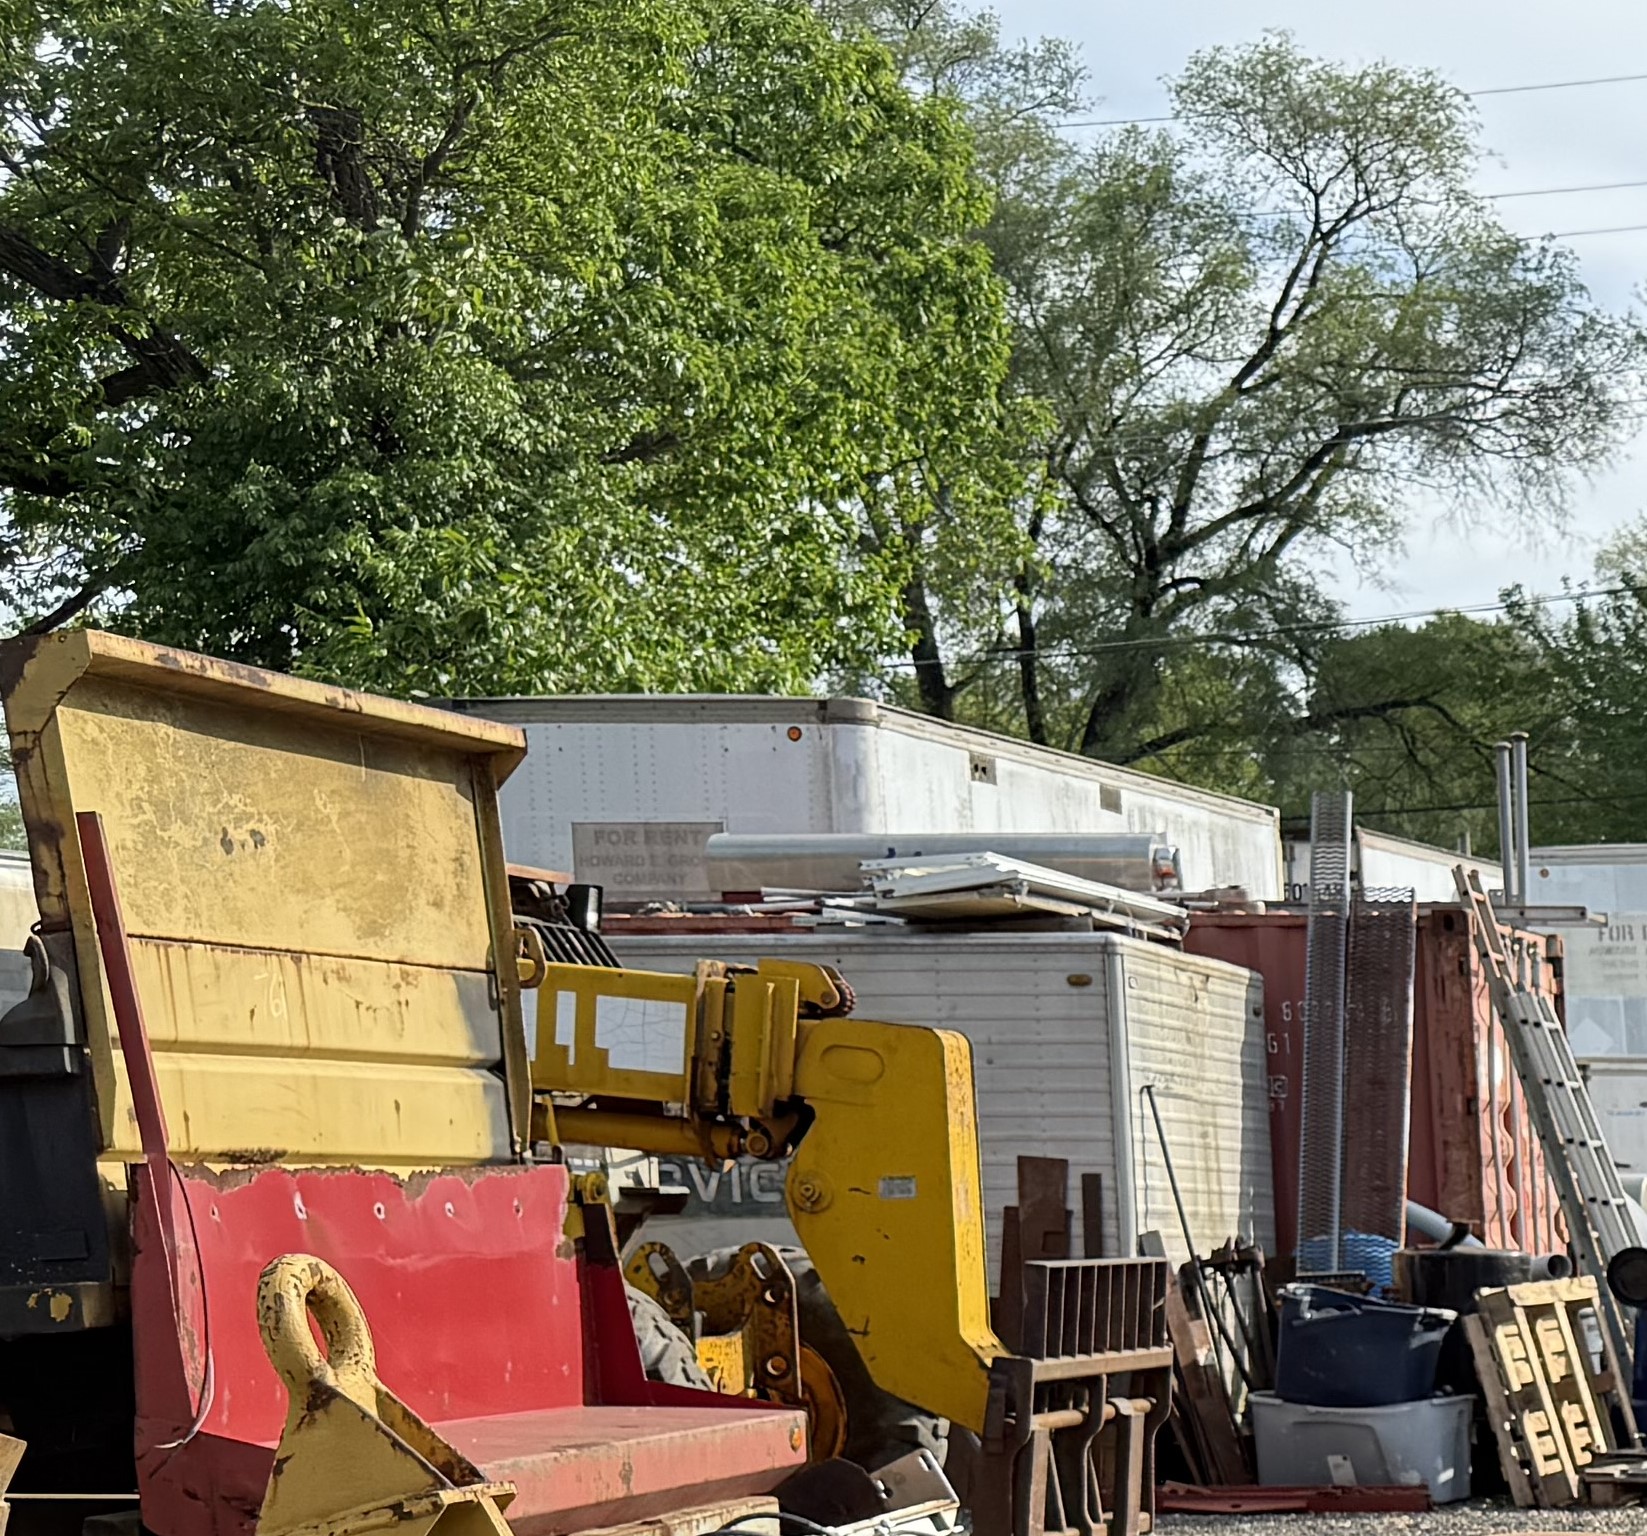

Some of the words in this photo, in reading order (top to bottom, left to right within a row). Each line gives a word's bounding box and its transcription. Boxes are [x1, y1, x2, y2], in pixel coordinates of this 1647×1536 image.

[594, 830, 637, 846] FOR
[643, 829, 702, 846] RENT
[579, 854, 645, 867] HOWARD
[667, 854, 700, 867] GRO
[612, 873, 687, 886] COMPANY
[1598, 924, 1634, 942] FOR
